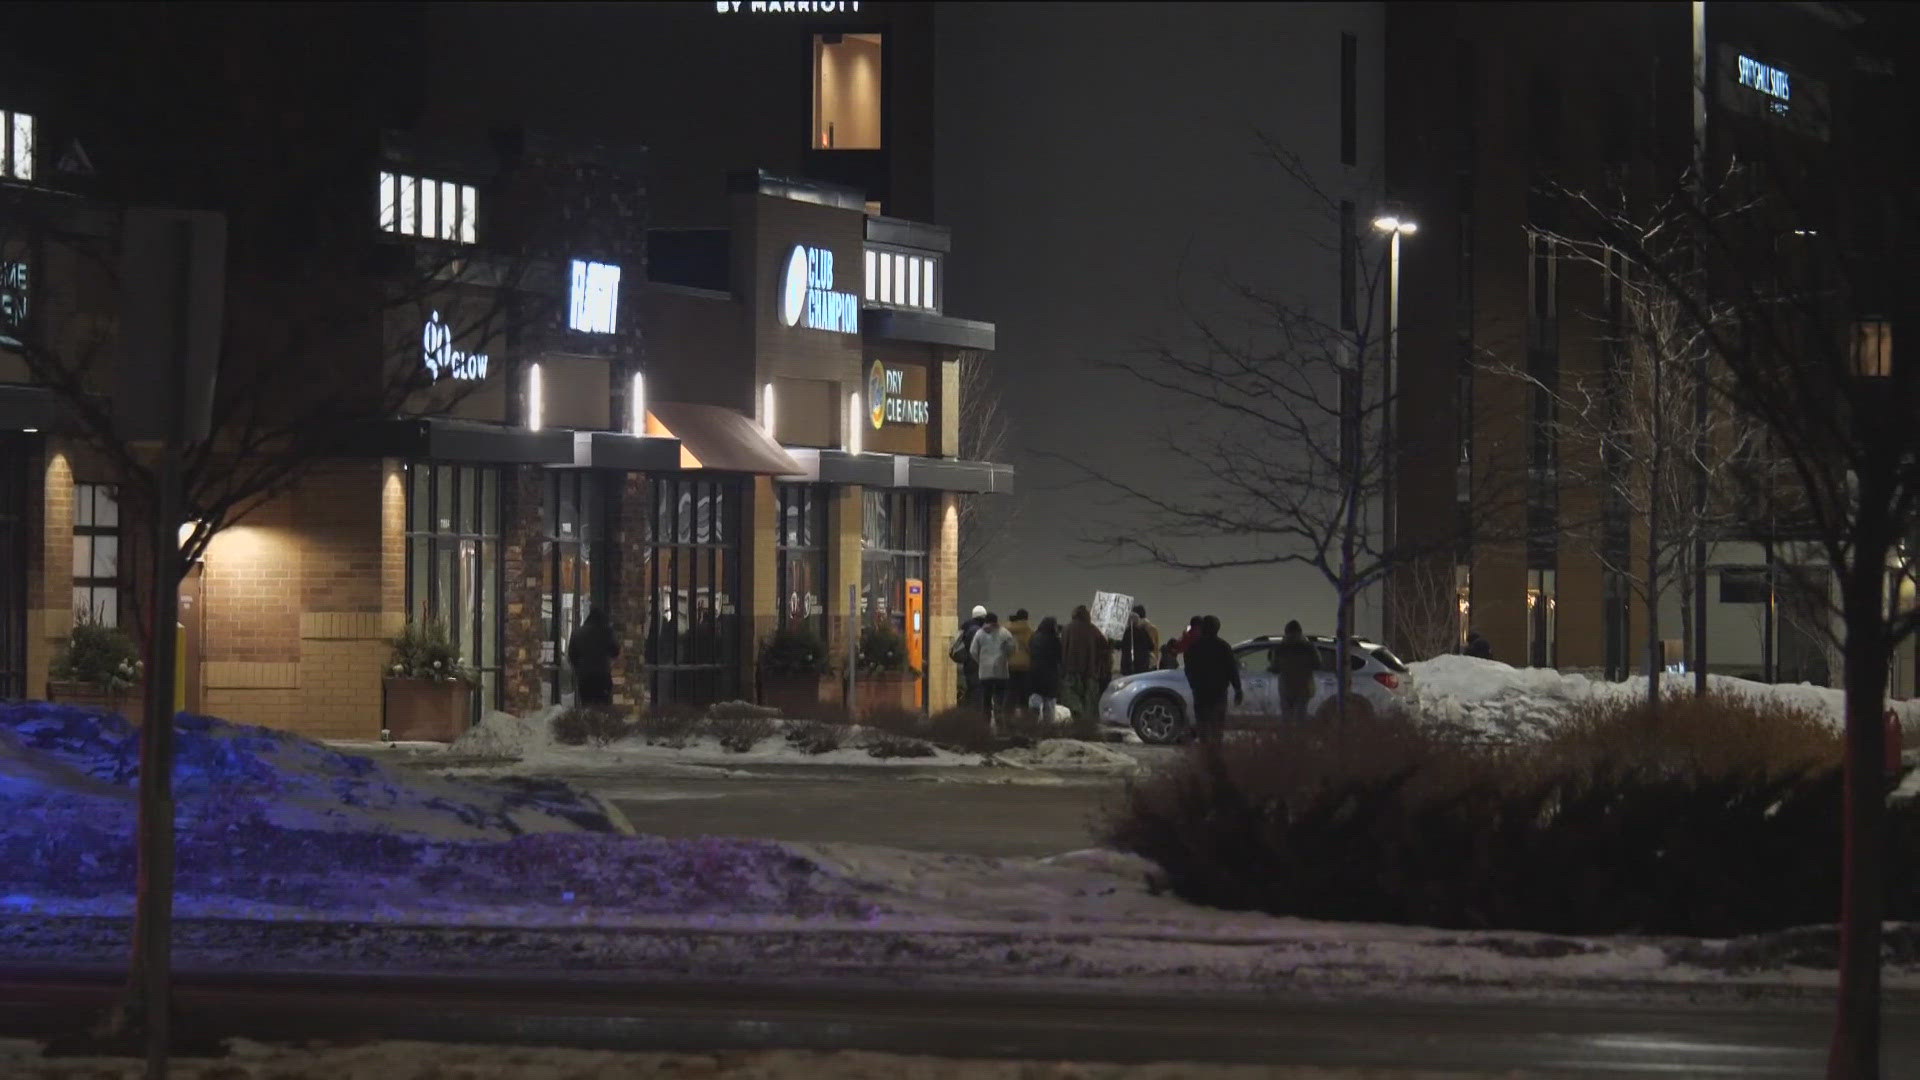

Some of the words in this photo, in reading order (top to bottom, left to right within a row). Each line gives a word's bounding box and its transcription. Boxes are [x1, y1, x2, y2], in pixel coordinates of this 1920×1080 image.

[808, 247, 833, 290] CLUB
[808, 289, 858, 334] CHAMPION
[451, 351, 488, 380] GLOW
[886, 369, 903, 394] DRY
[886, 397, 929, 425] CLEANERS
